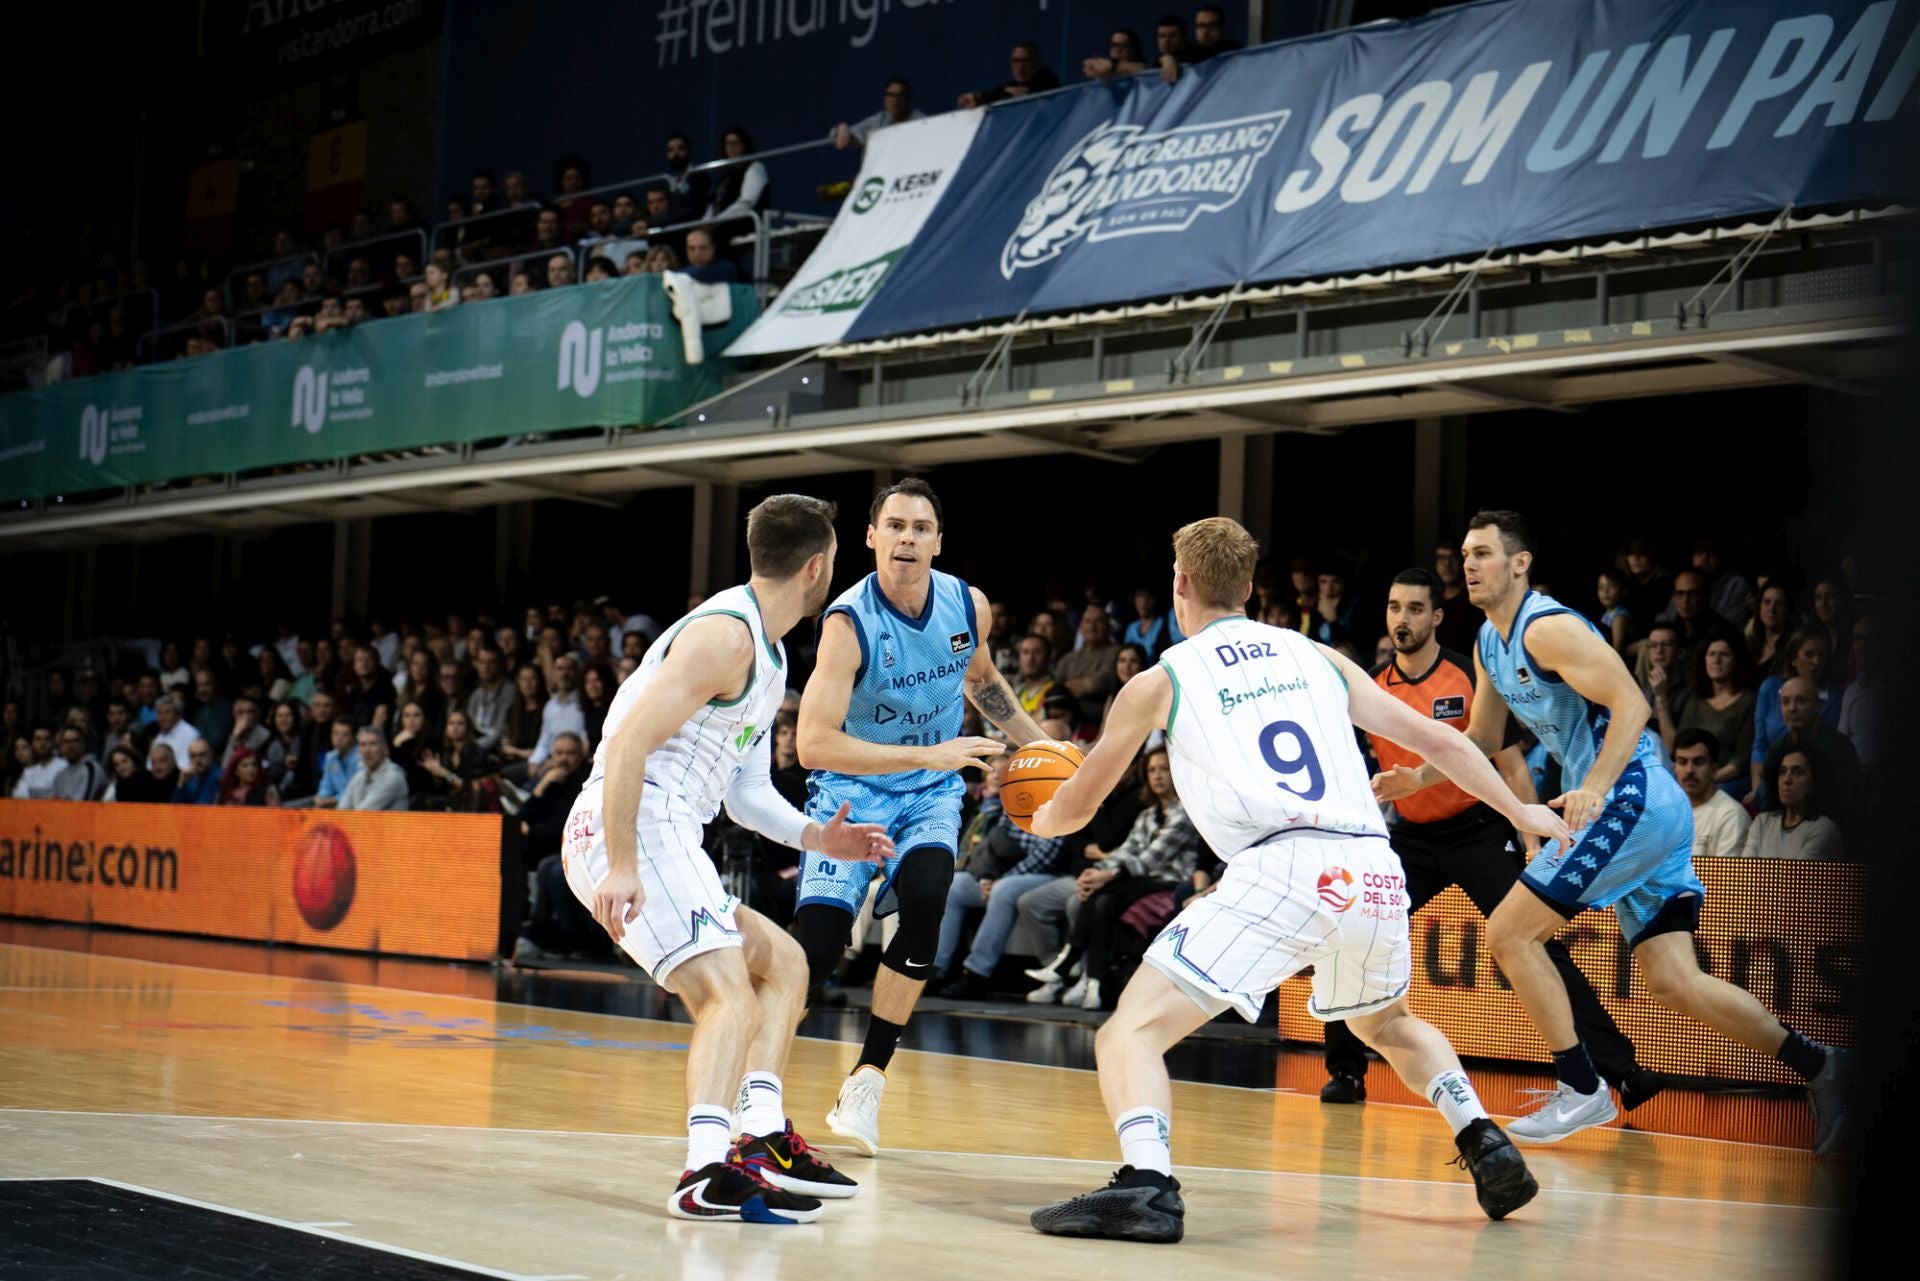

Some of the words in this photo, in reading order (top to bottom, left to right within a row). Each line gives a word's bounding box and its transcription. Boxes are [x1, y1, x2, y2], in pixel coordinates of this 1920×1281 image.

[1274, 60, 1553, 214] SOM
[1525, 27, 1736, 173] UN
[1118, 123, 1275, 170] MORABANC
[890, 169, 943, 194] KERN
[1086, 153, 1251, 214] ANDORRA
[1215, 640, 1278, 668] Díaz
[1008, 757, 1042, 773] EVO
[1258, 719, 1327, 802] 9
[1363, 890, 1387, 906] DEL
